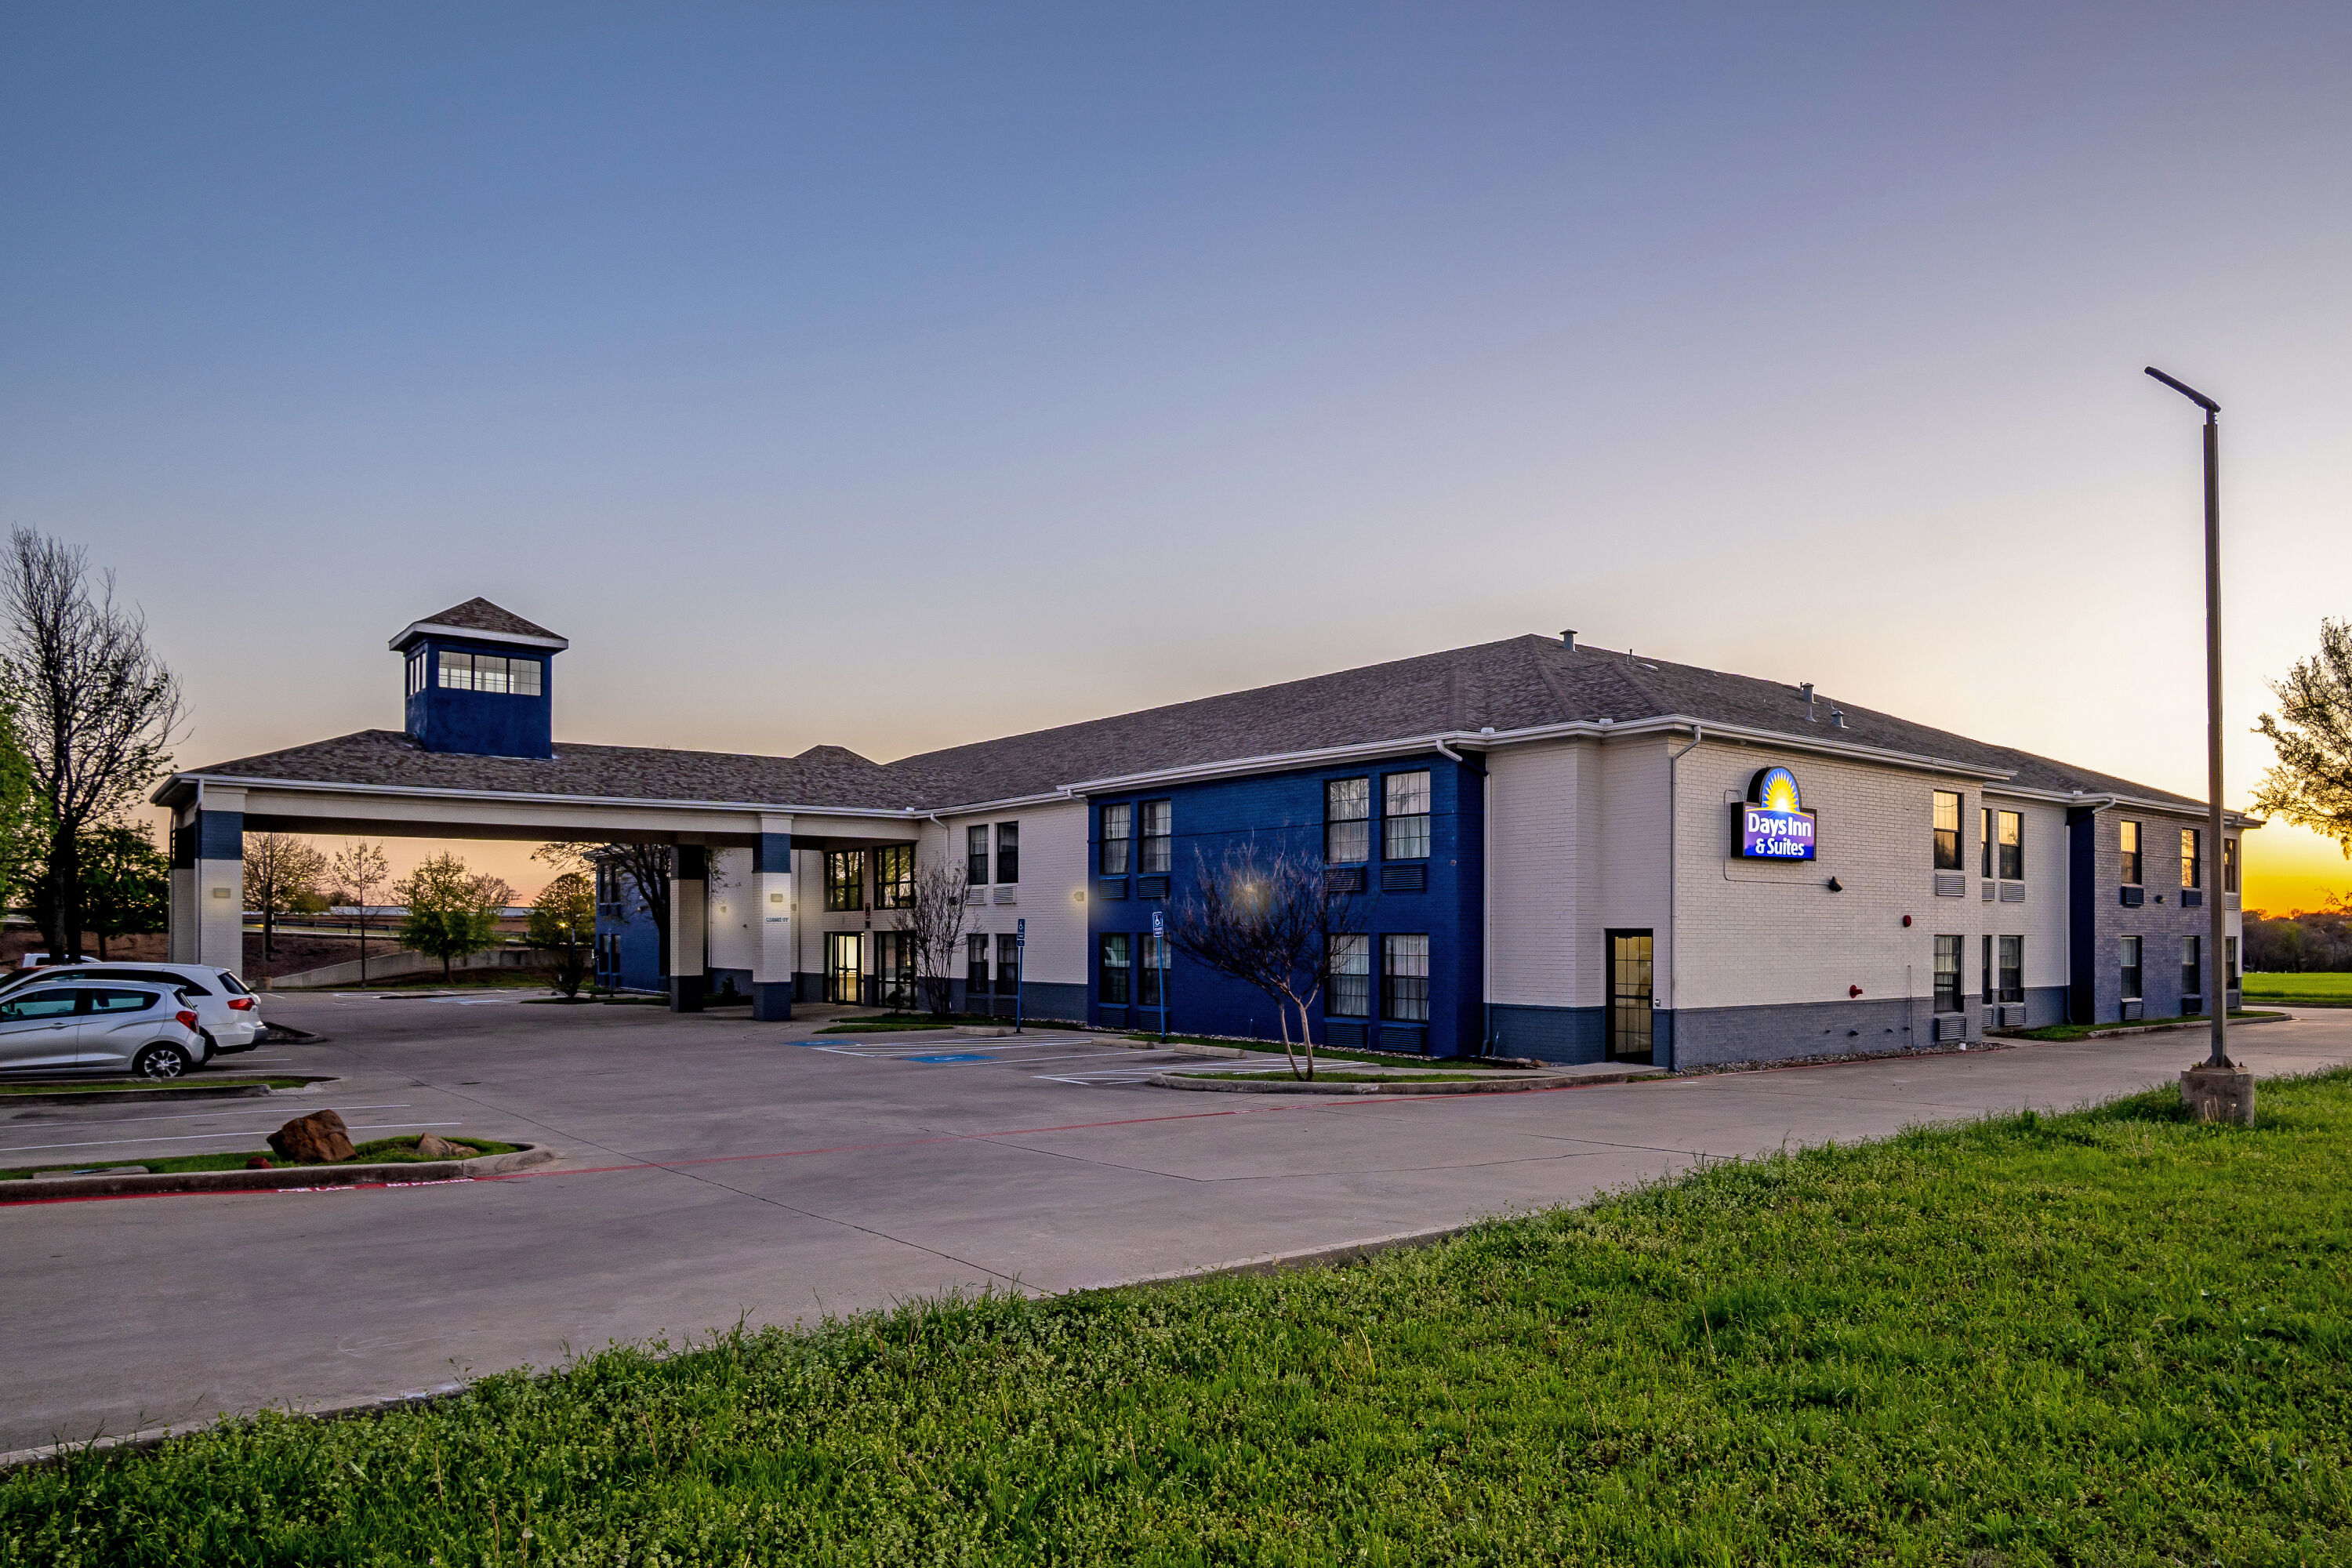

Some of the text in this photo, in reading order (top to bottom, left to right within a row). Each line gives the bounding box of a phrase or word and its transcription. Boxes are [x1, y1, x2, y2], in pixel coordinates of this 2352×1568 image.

[1748, 813, 1812, 837] Days Inn
[1755, 837, 1805, 856] & Suites
